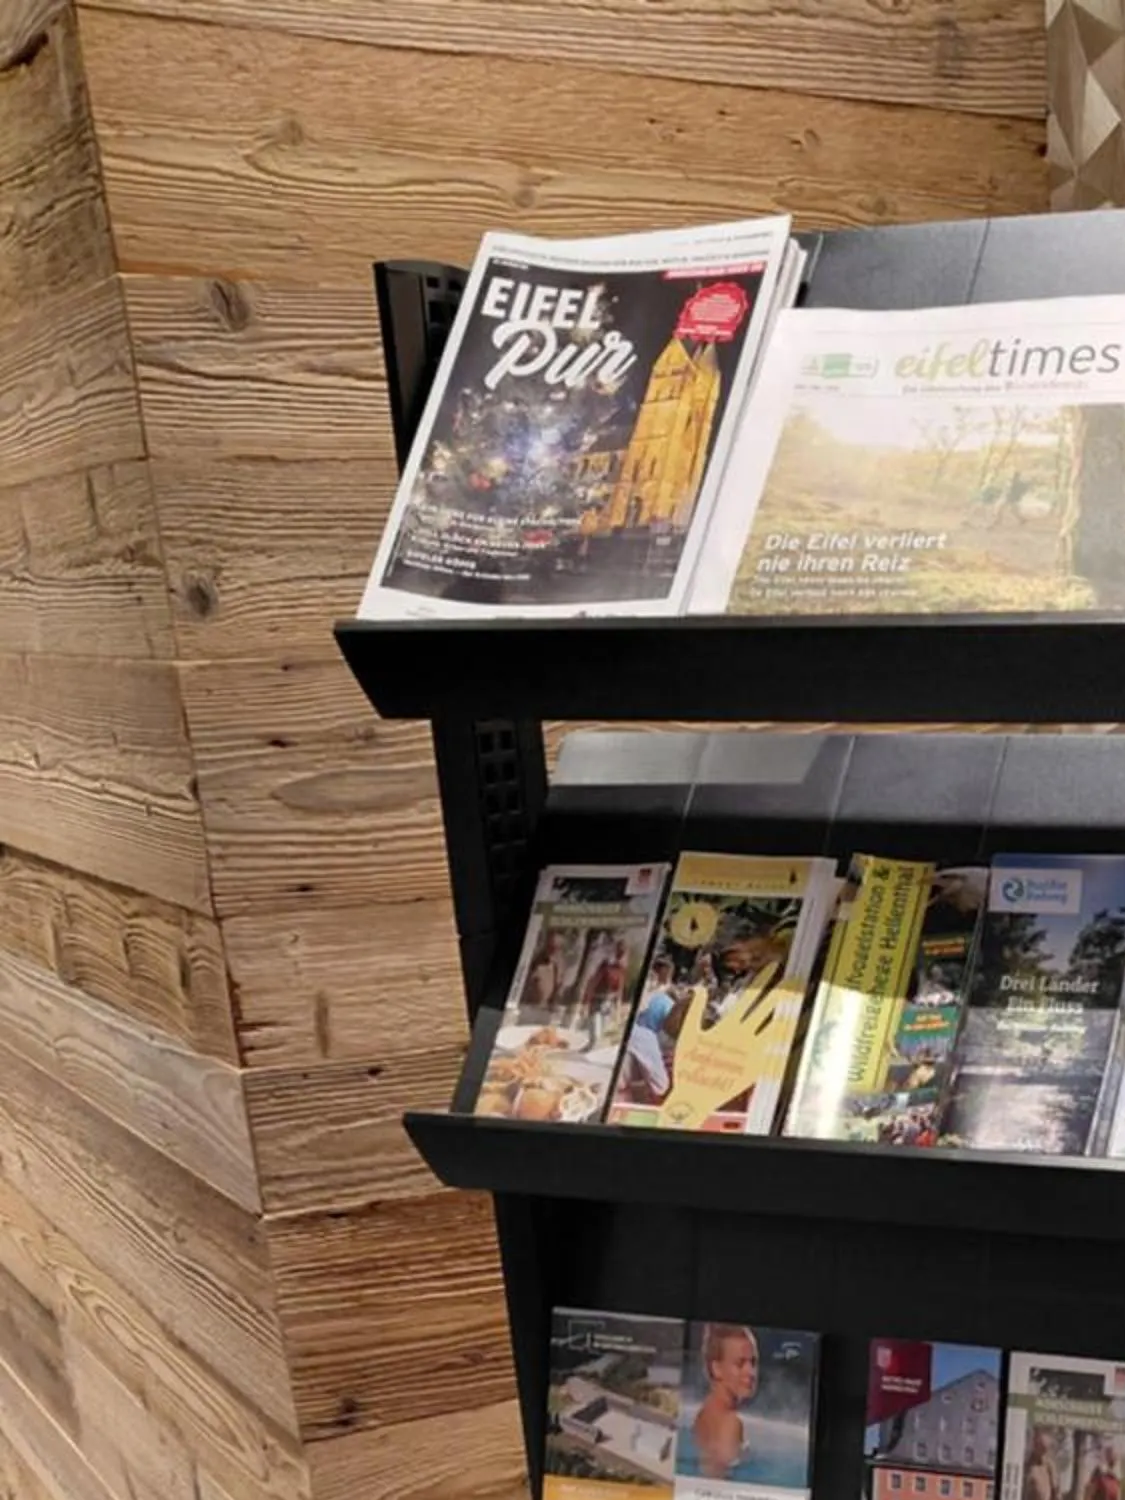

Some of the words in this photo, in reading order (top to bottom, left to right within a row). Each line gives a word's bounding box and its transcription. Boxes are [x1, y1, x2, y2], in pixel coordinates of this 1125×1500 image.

[480, 276, 600, 329] EIFEL
[484, 318, 639, 389] Pur
[895, 338, 1121, 378] eifeltimes
[765, 534, 800, 550] Die
[807, 533, 857, 550] Eifel
[864, 531, 948, 550] verliert
[757, 555, 790, 572] nie
[797, 553, 855, 573] ihren
[861, 554, 912, 573] Reiz
